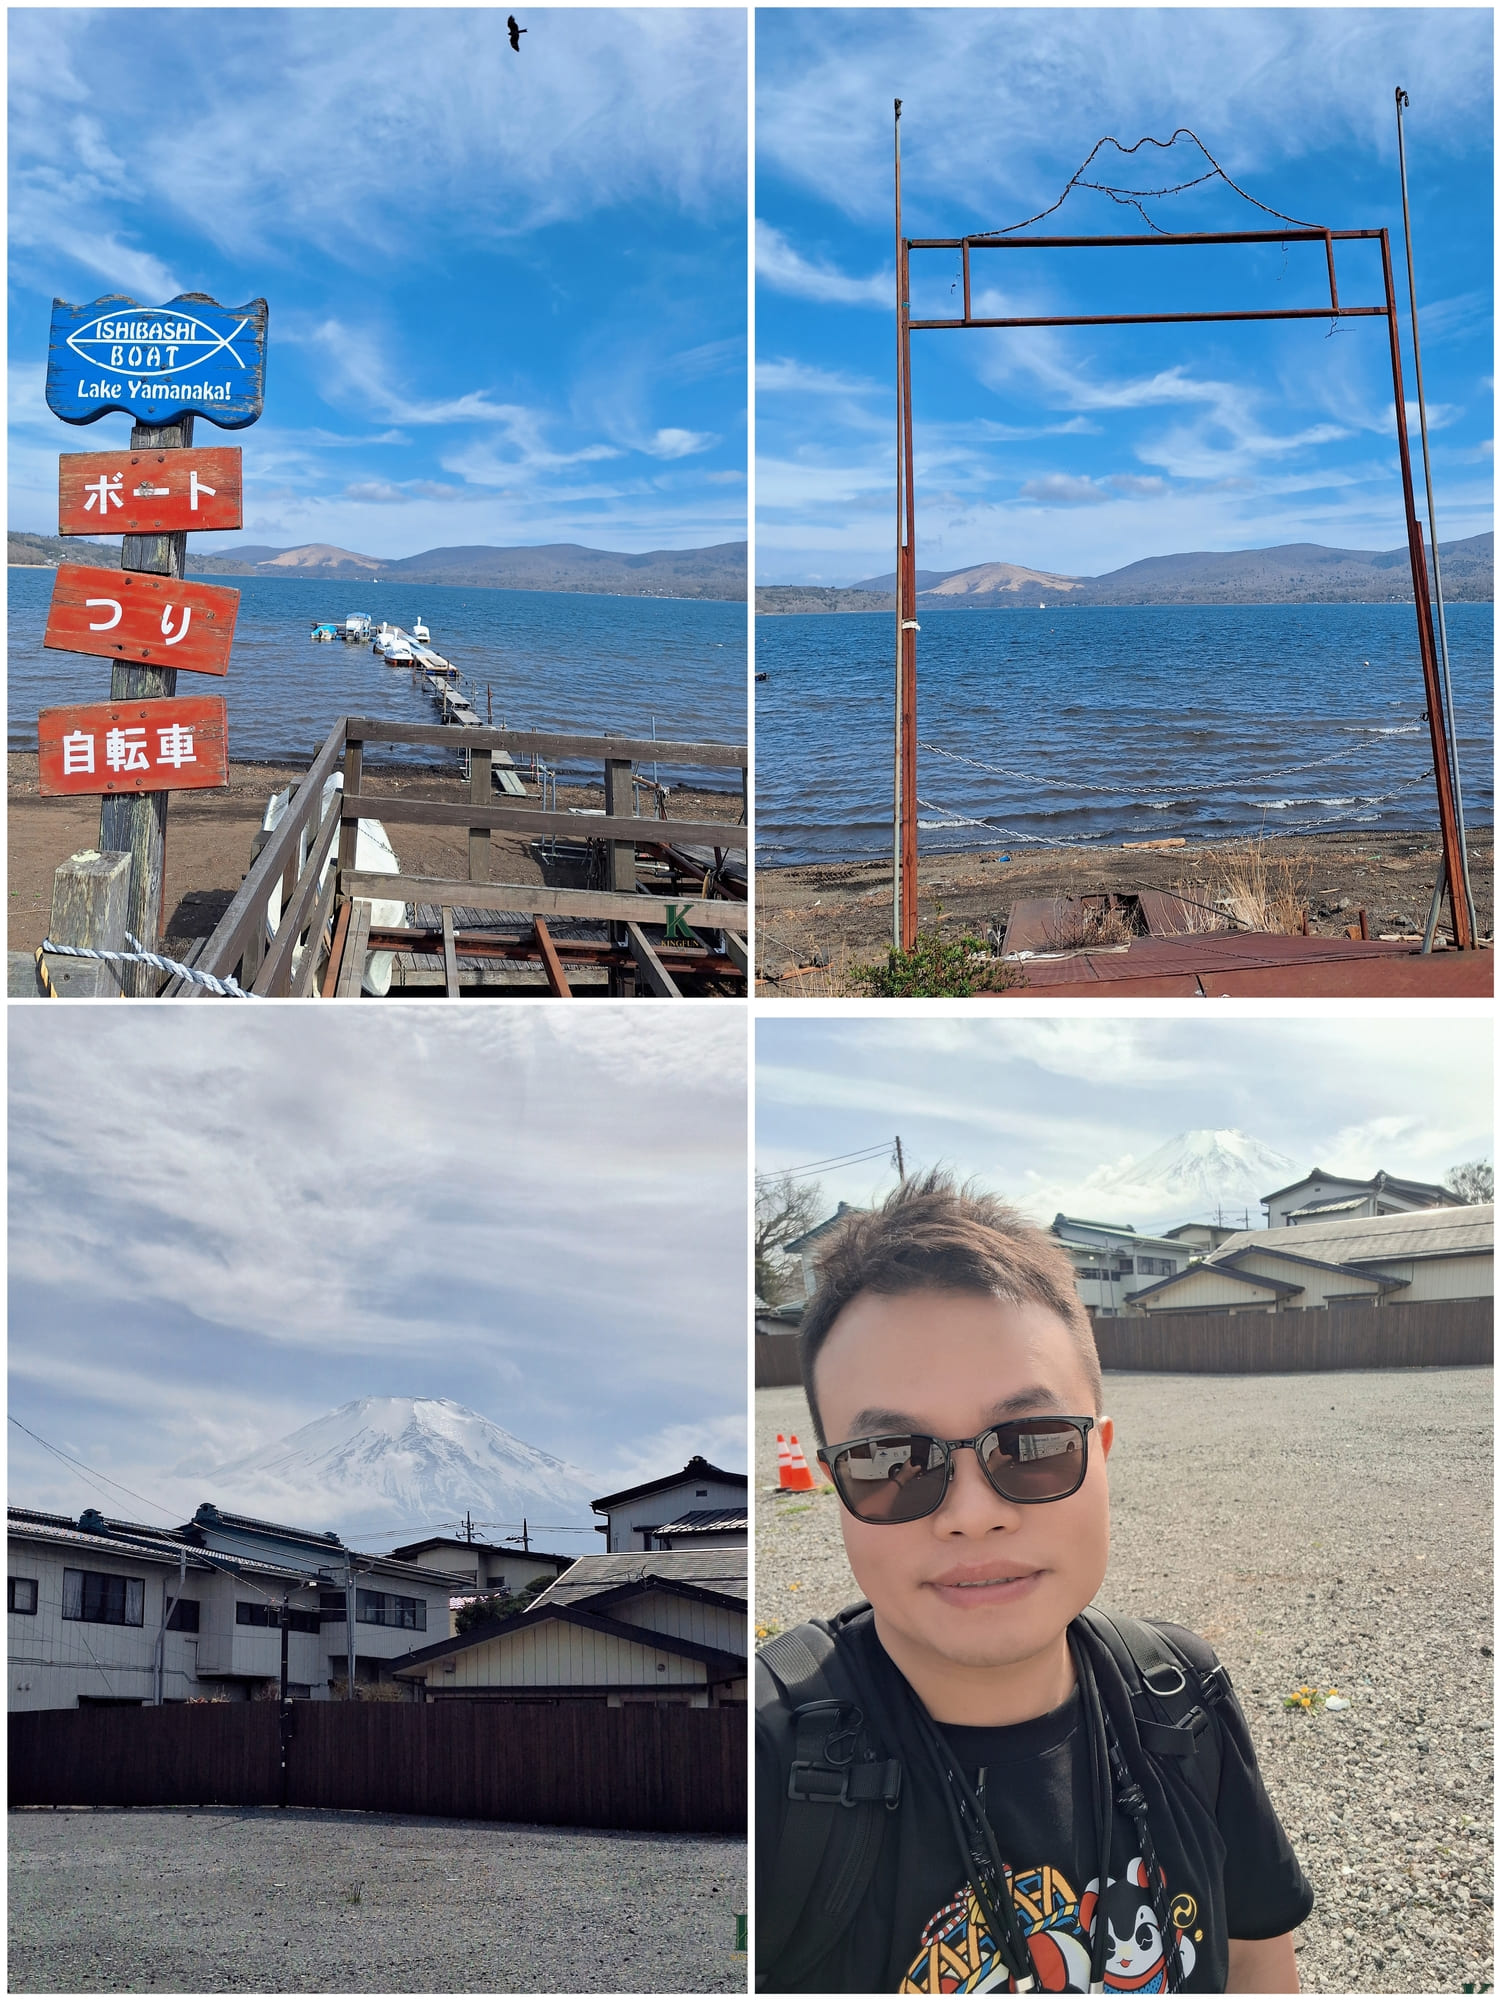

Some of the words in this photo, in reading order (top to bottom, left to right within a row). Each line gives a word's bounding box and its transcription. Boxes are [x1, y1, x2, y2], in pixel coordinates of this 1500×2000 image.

[95, 321, 197, 340] ISHIBASHI
[110, 345, 180, 367] BOAT
[77, 379, 122, 399] Lake
[127, 380, 232, 401] Yamanaka!
[83, 470, 217, 515] ボート
[85, 598, 192, 646] つり
[62, 722, 198, 776] 自転車
